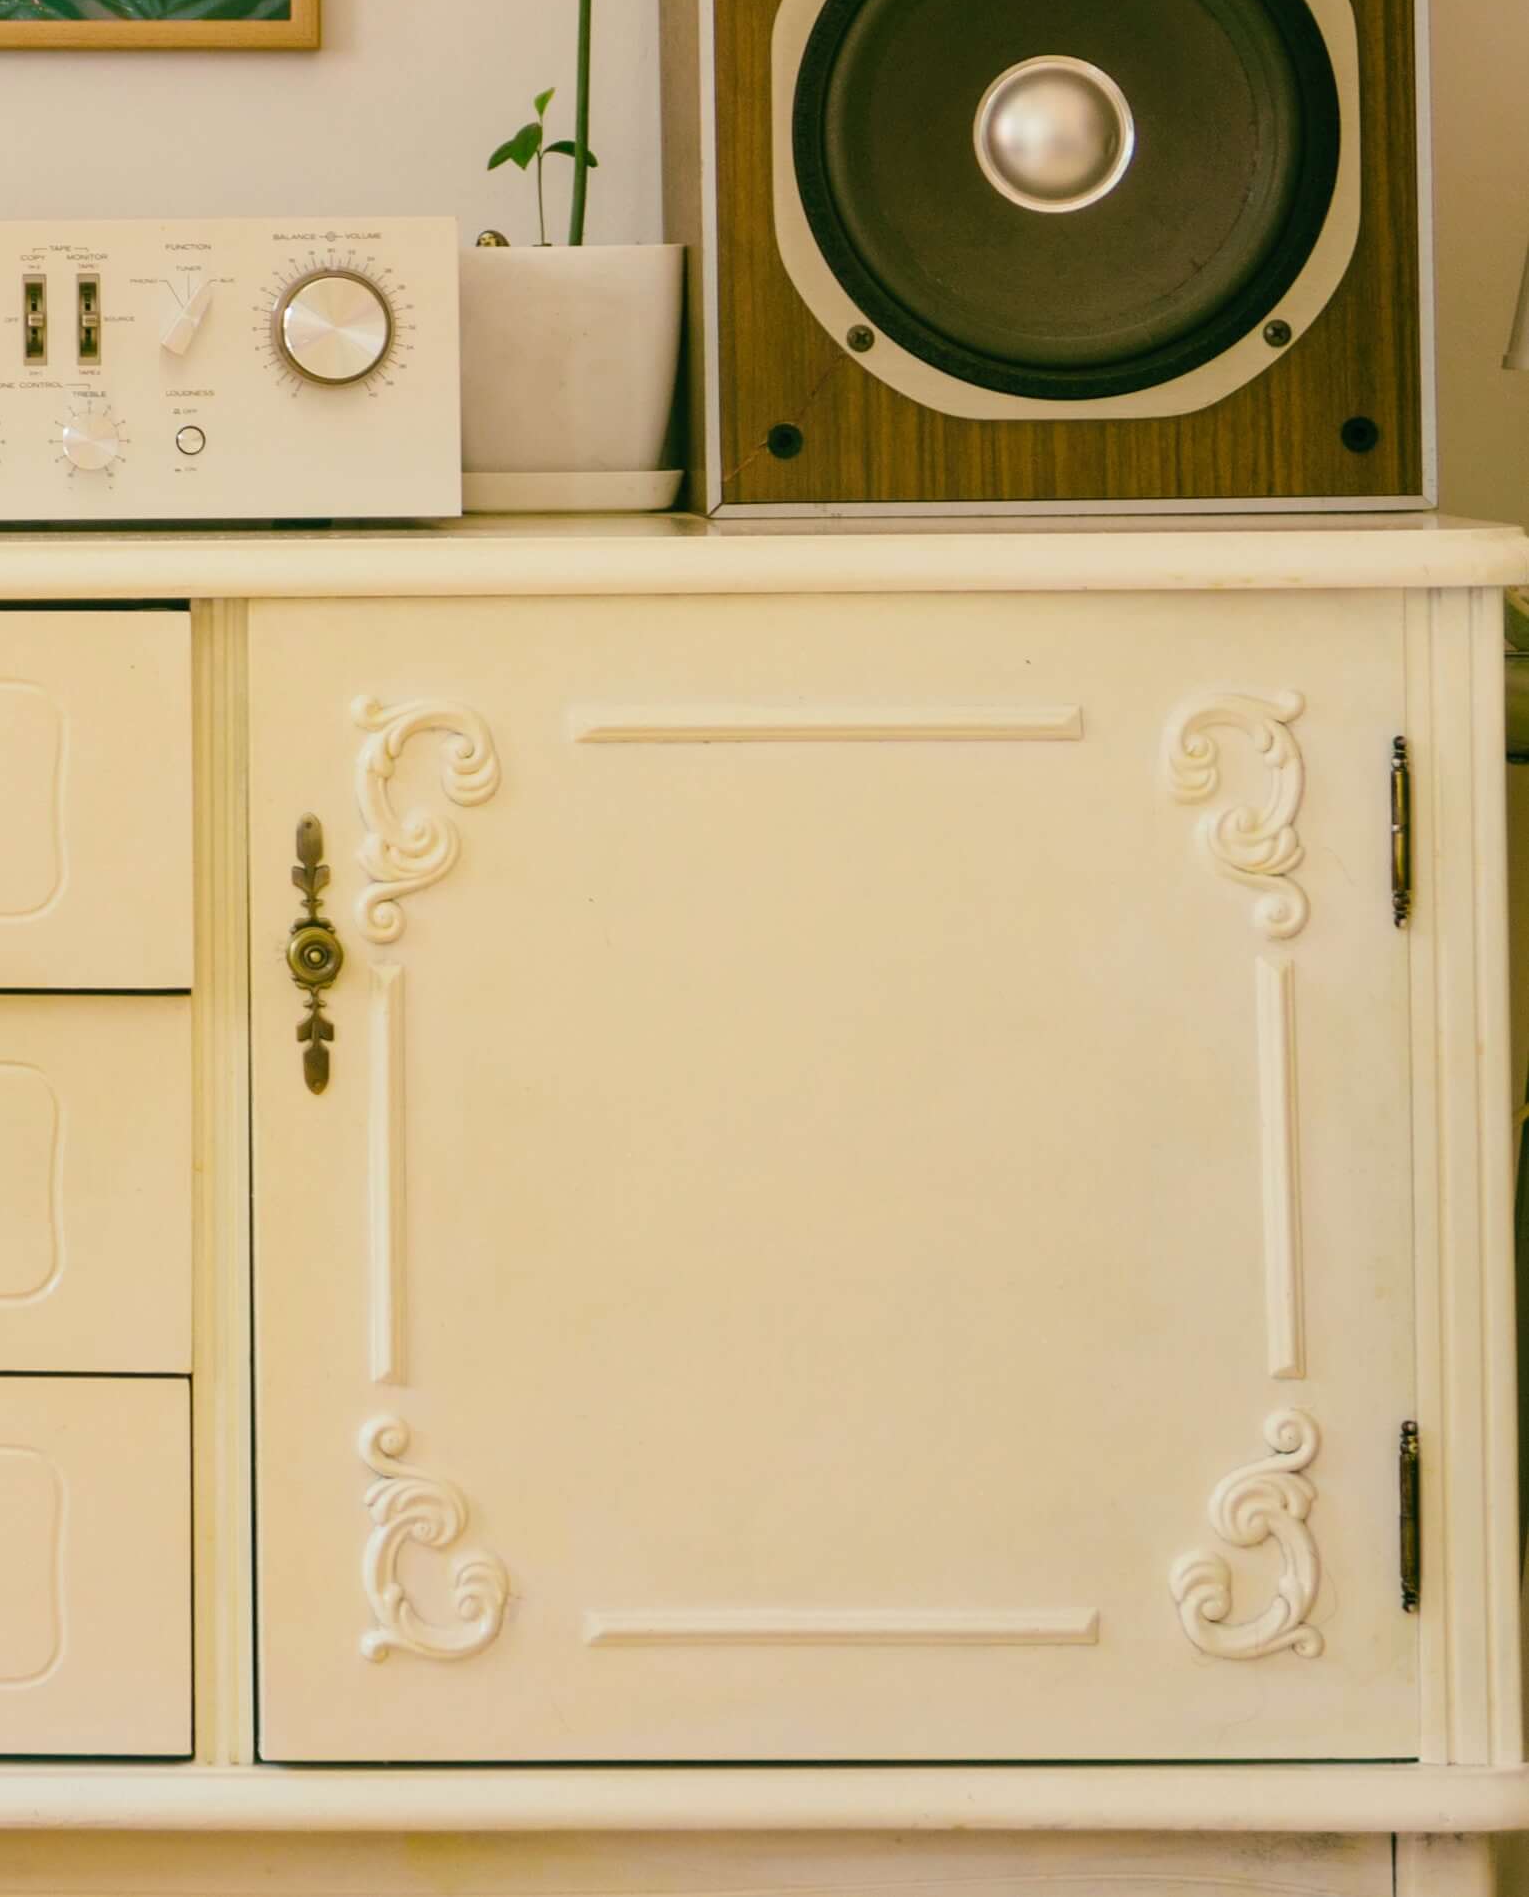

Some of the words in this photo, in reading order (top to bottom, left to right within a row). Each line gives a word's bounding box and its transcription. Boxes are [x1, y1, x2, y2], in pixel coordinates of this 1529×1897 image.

[272, 233, 316, 241] BALANCE
[345, 232, 382, 240] VOLUME
[165, 243, 212, 251] FUNCTION
[66, 253, 108, 261] MONITOR
[19, 381, 64, 389] CONTROL
[72, 390, 107, 398] TREBLE
